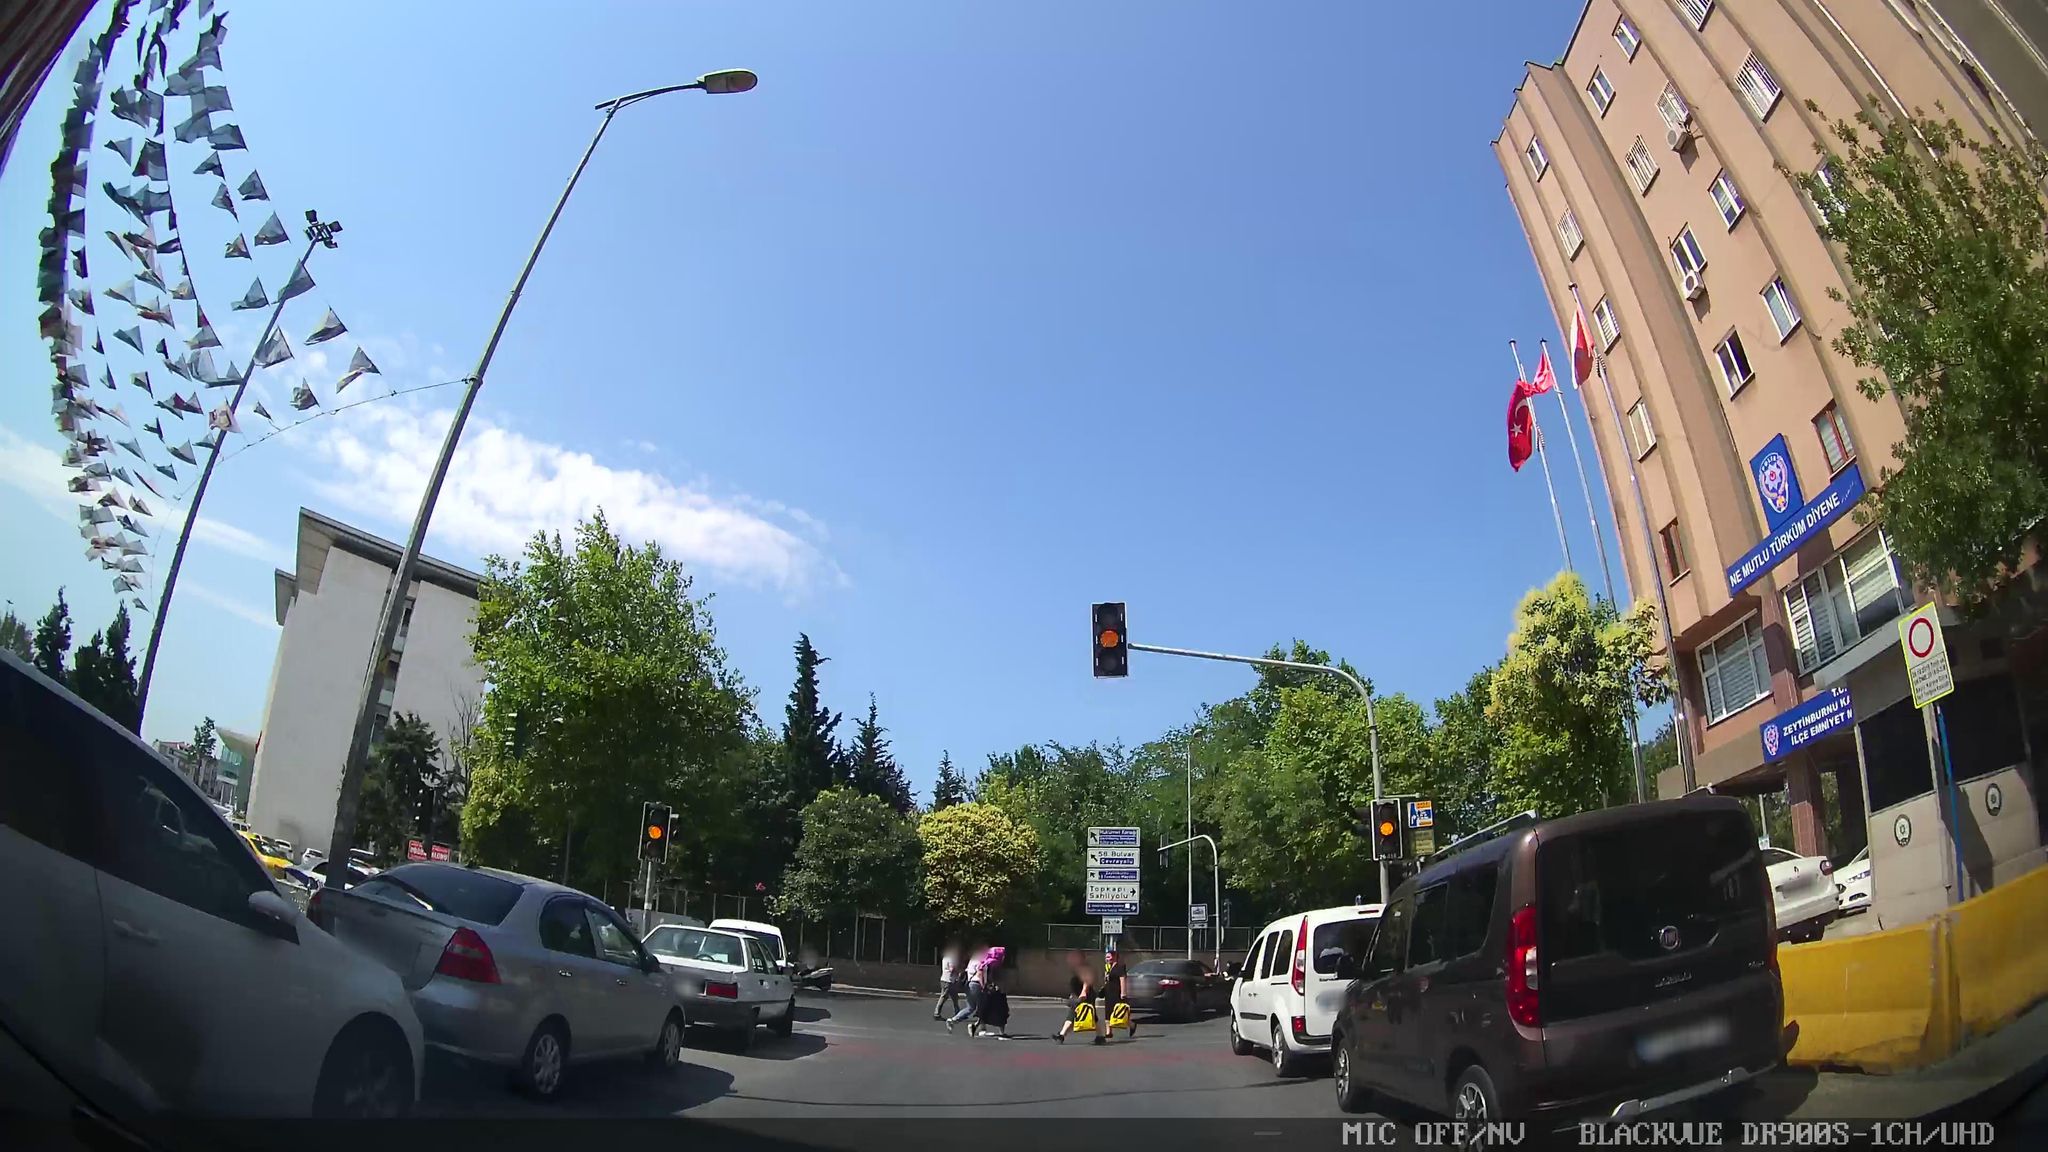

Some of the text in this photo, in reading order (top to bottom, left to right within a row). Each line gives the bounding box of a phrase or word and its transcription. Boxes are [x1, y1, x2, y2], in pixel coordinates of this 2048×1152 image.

[1729, 570, 1743, 587] NE
[1742, 551, 1770, 578] MUTLU
[1769, 522, 1807, 556] TÜRKÜM
[1806, 492, 1841, 527] DİYENE
[1783, 701, 1839, 737] ZEYTİNBURNU
[1791, 730, 1810, 746] İLÇE
[1810, 712, 1845, 737] EMNİYET
